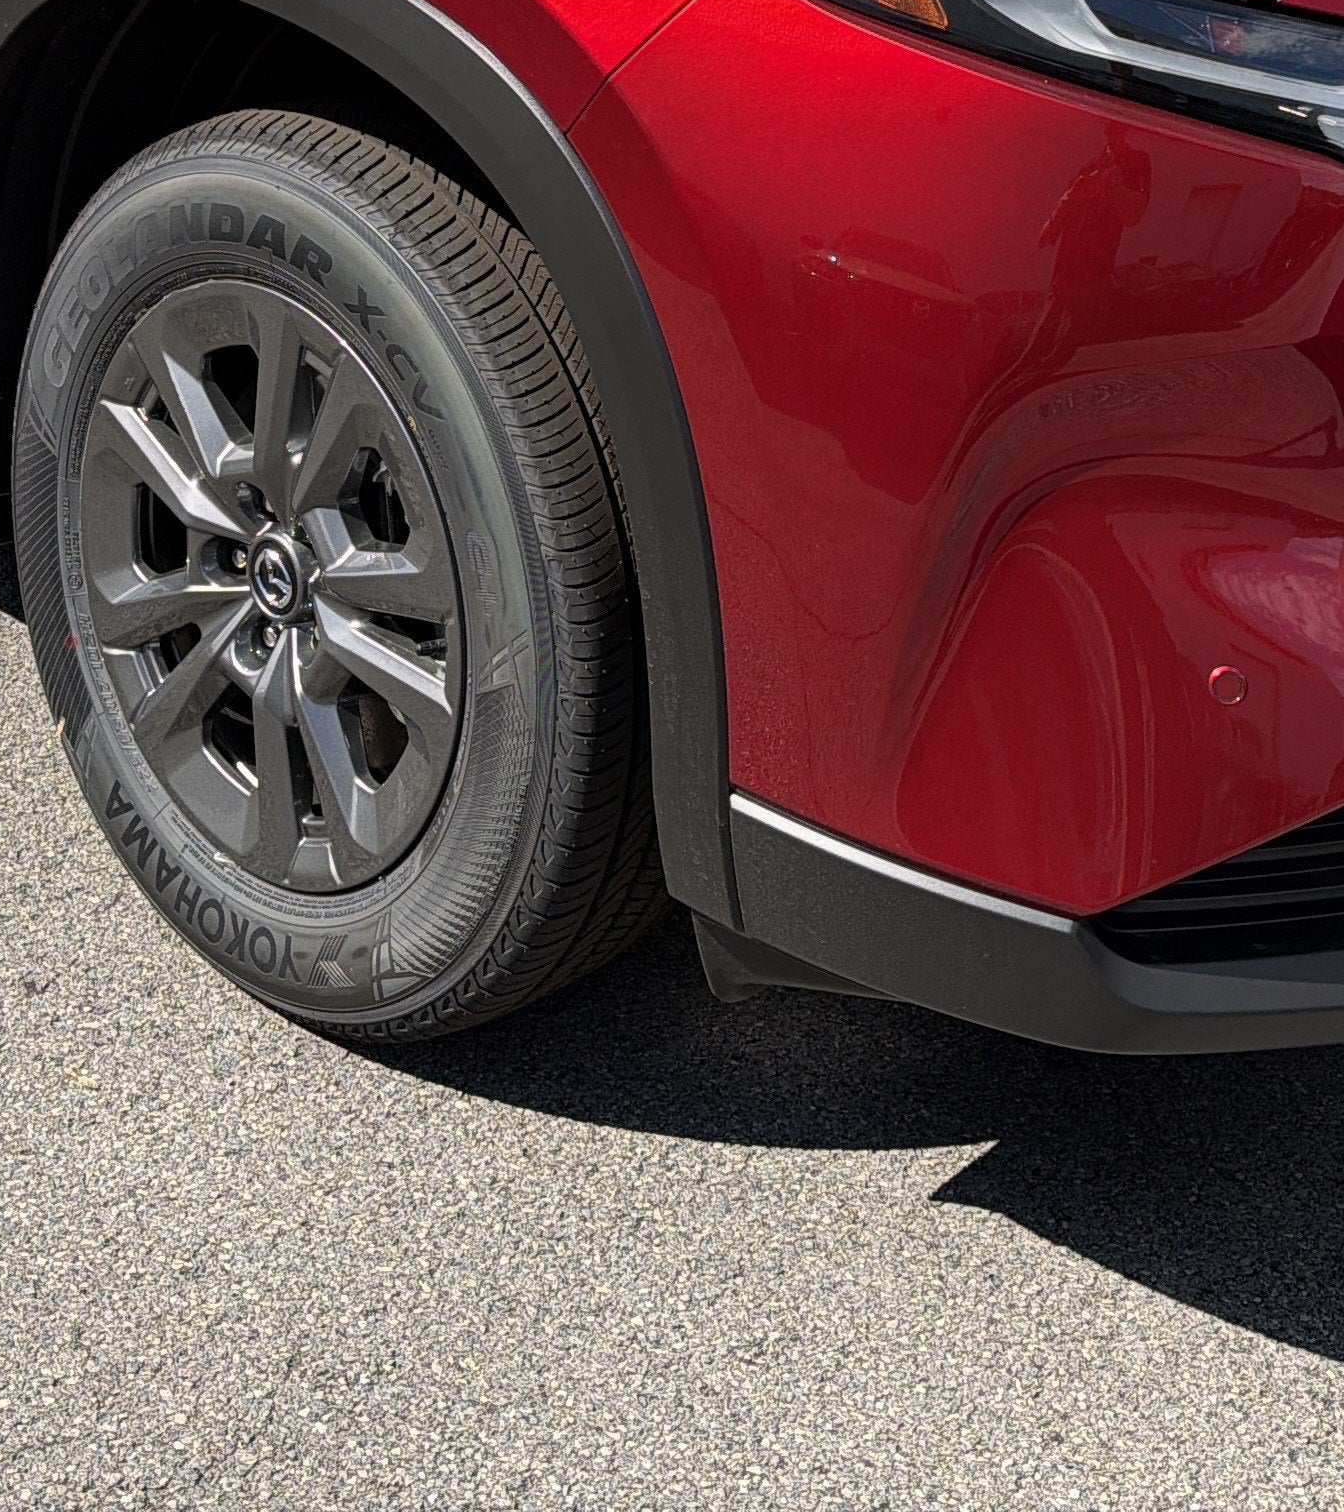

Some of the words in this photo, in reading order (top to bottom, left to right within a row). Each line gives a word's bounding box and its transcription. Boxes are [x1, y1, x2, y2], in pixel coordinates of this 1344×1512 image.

[48, 202, 334, 387] GEOLANDAR
[343, 286, 446, 422] X-CV
[106, 779, 301, 981] YOKOHAMA
